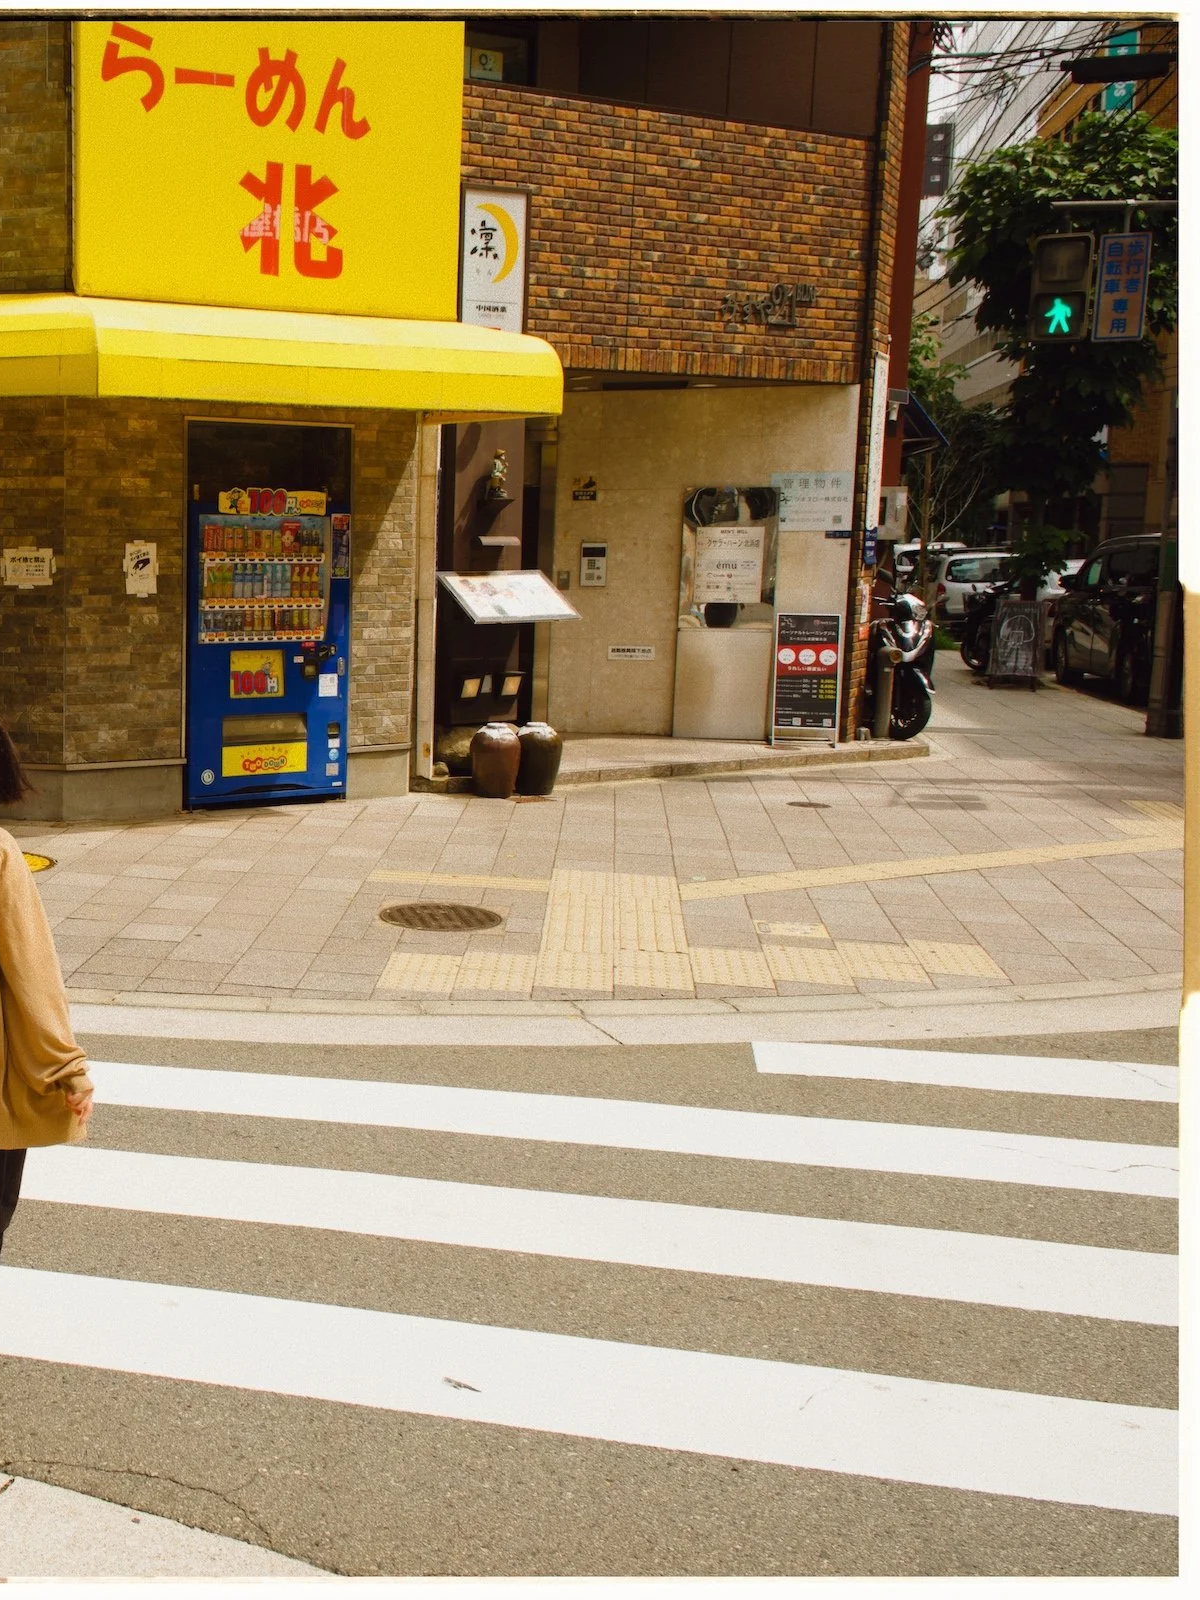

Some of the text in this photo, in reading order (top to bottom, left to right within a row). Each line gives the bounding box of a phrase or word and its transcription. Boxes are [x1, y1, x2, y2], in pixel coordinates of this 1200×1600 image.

[101, 22, 371, 140] らーめん
[238, 160, 344, 280] 北
[1104, 242, 1124, 295] 自転車
[1125, 240, 1144, 293] 歩行者
[1109, 298, 1129, 334] 専用
[783, 477, 842, 489] 管理物件
[10, 556, 46, 564] ポイ捨て禁止
[263, 755, 287, 770] DOWN
